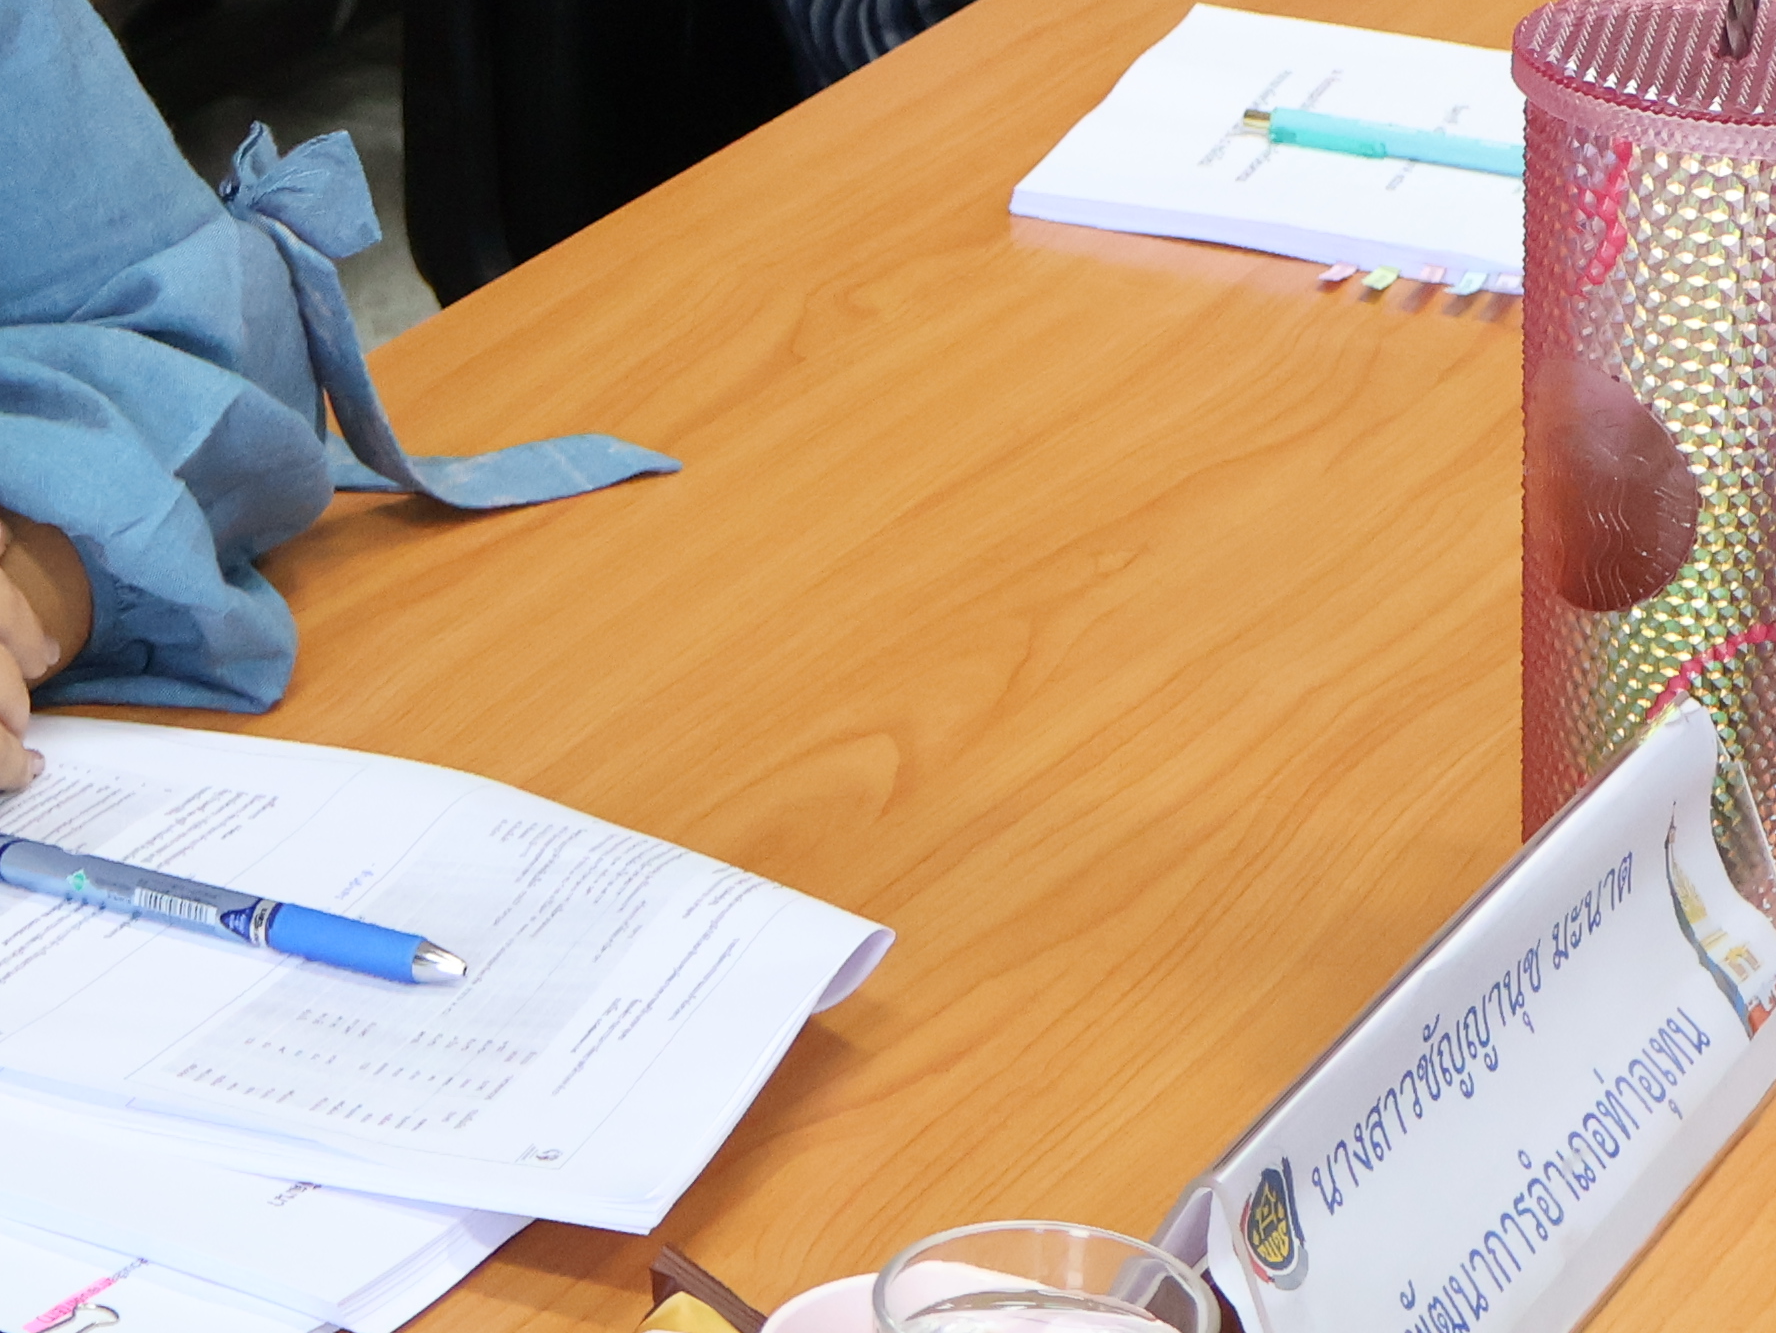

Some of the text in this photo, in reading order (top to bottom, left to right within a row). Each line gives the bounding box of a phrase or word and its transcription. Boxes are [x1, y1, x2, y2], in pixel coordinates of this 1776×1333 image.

[1400, 1005, 1711, 1333] ัฒนาการอำเภอท่าอุเทน
